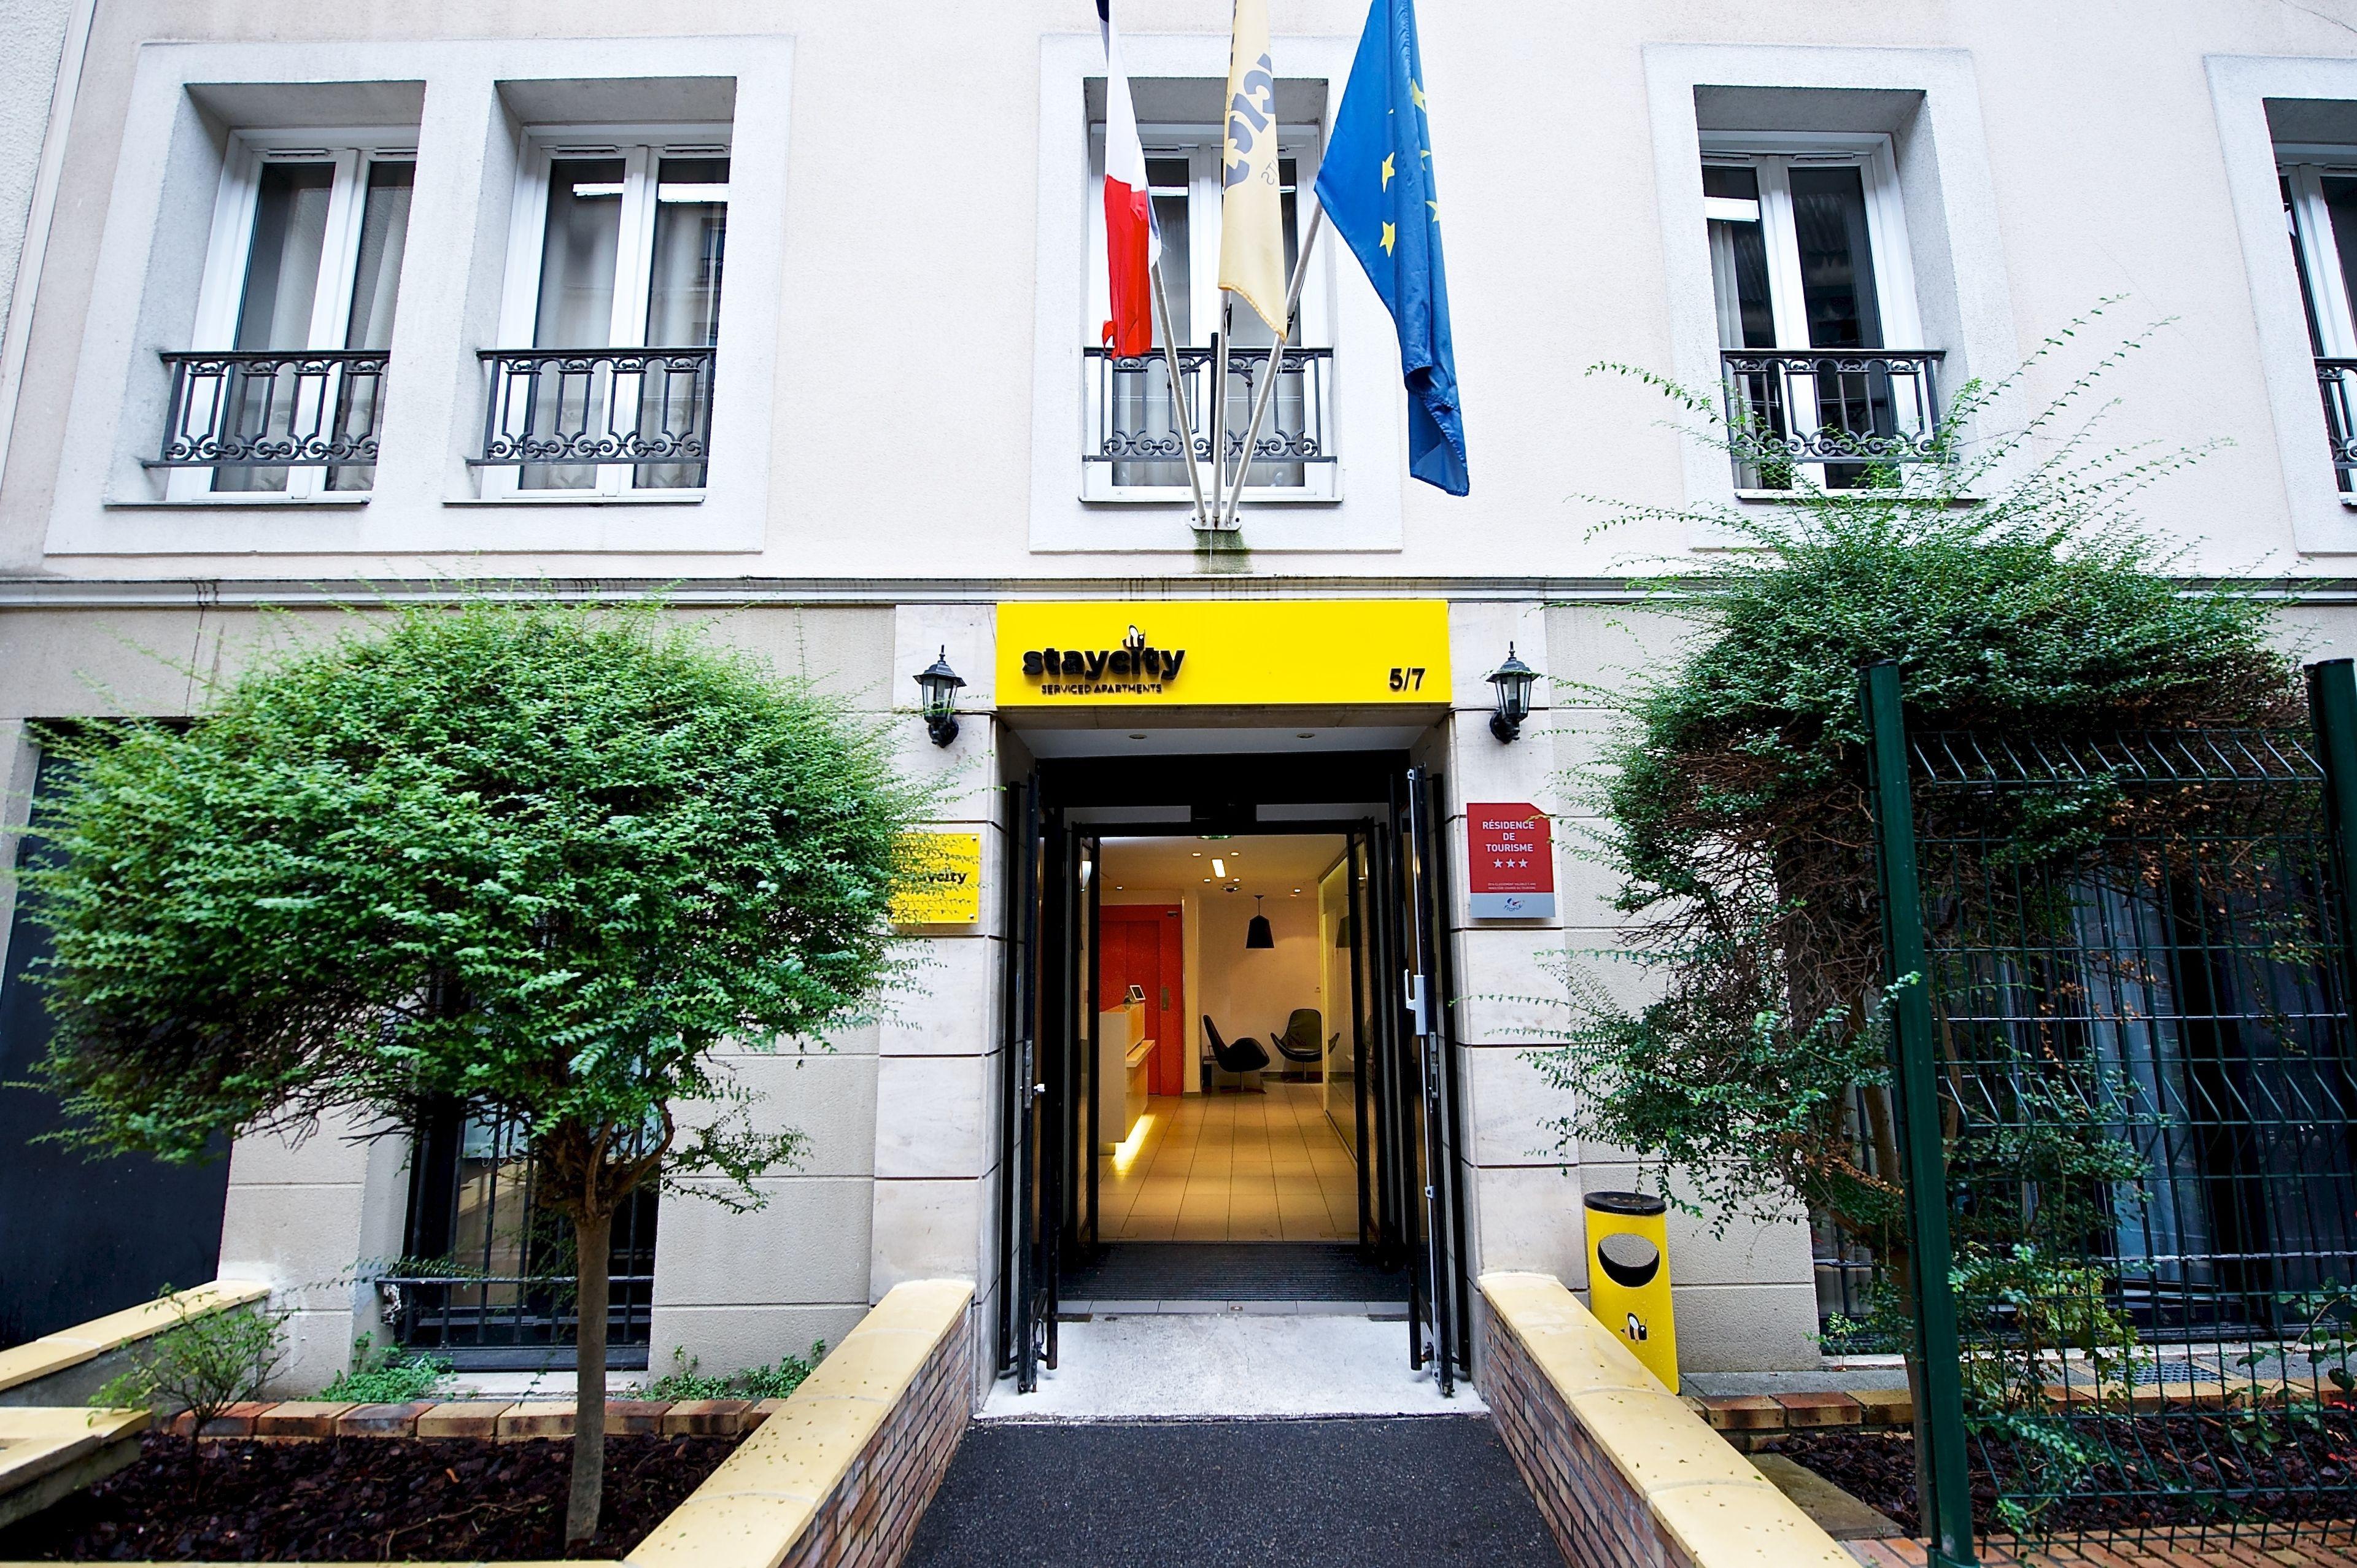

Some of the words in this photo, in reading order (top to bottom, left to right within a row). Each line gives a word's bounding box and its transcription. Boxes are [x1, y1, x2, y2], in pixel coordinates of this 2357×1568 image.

[1022, 647, 1185, 681] staycity
[1389, 667, 1425, 692] 5/7
[1042, 684, 1091, 695] SERVICED
[1093, 684, 1163, 695] APARTMENTS
[1482, 819, 1535, 830] RÉSIDENCE
[1503, 832, 1515, 841] DE
[1485, 843, 1534, 852] TOURISME
